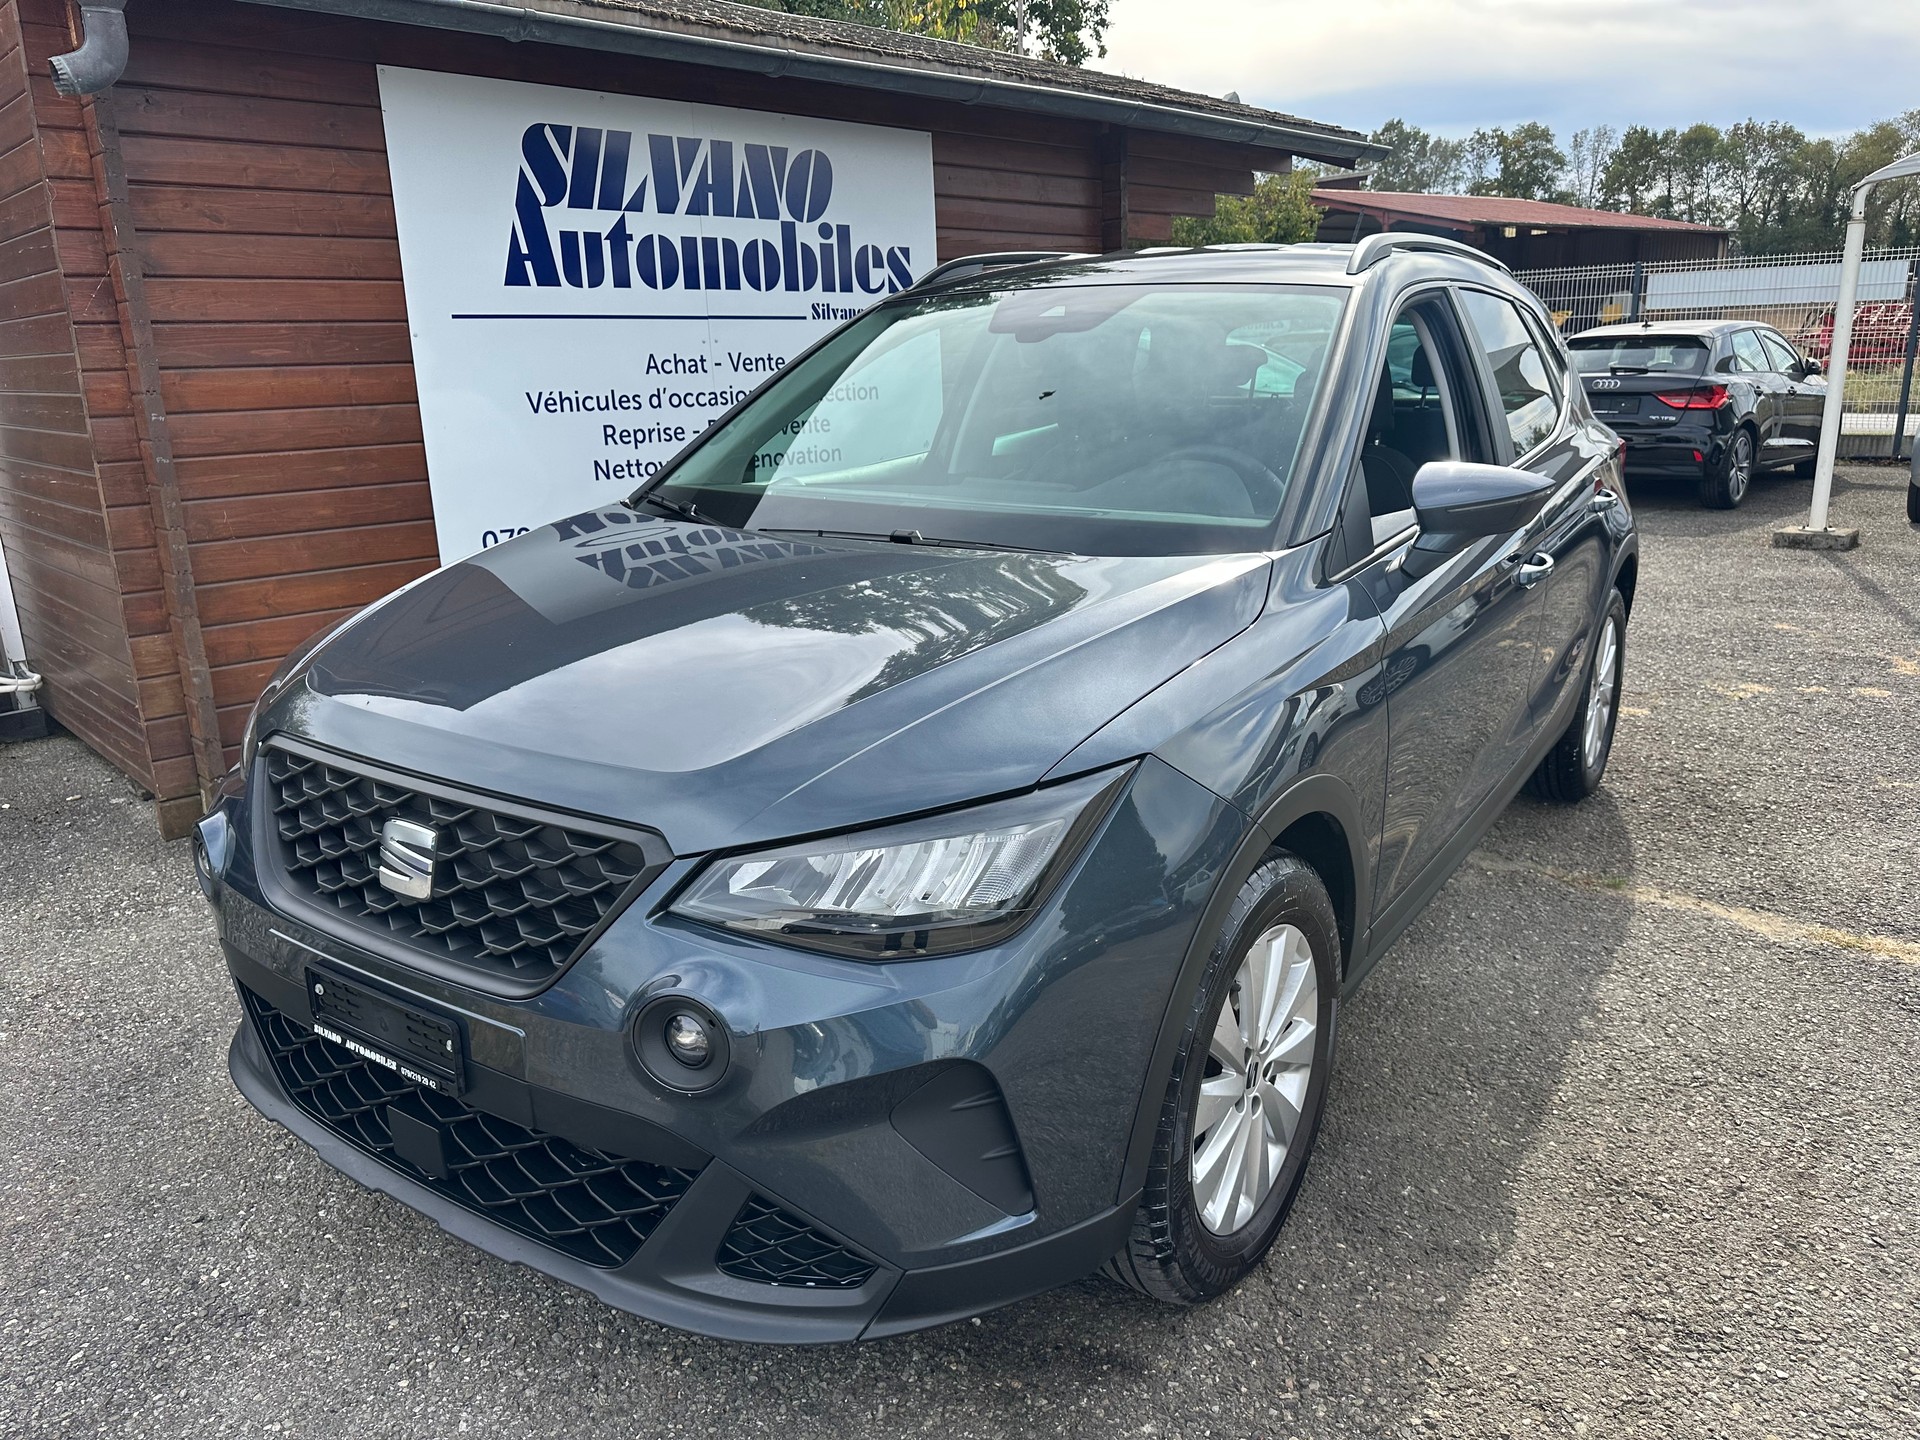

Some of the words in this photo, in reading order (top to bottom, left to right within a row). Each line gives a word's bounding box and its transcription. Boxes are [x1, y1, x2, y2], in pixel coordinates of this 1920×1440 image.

[518, 122, 833, 224] SILVANO
[504, 165, 914, 294] Automobiles
[645, 352, 709, 375] Achat
[727, 352, 786, 375] Vente
[526, 389, 642, 415] Véhicules
[649, 386, 752, 411] d'occasio
[603, 422, 687, 447] Reprise
[313, 1023, 342, 1044] SILVANO
[345, 1039, 397, 1071] AUTOMOBILES
